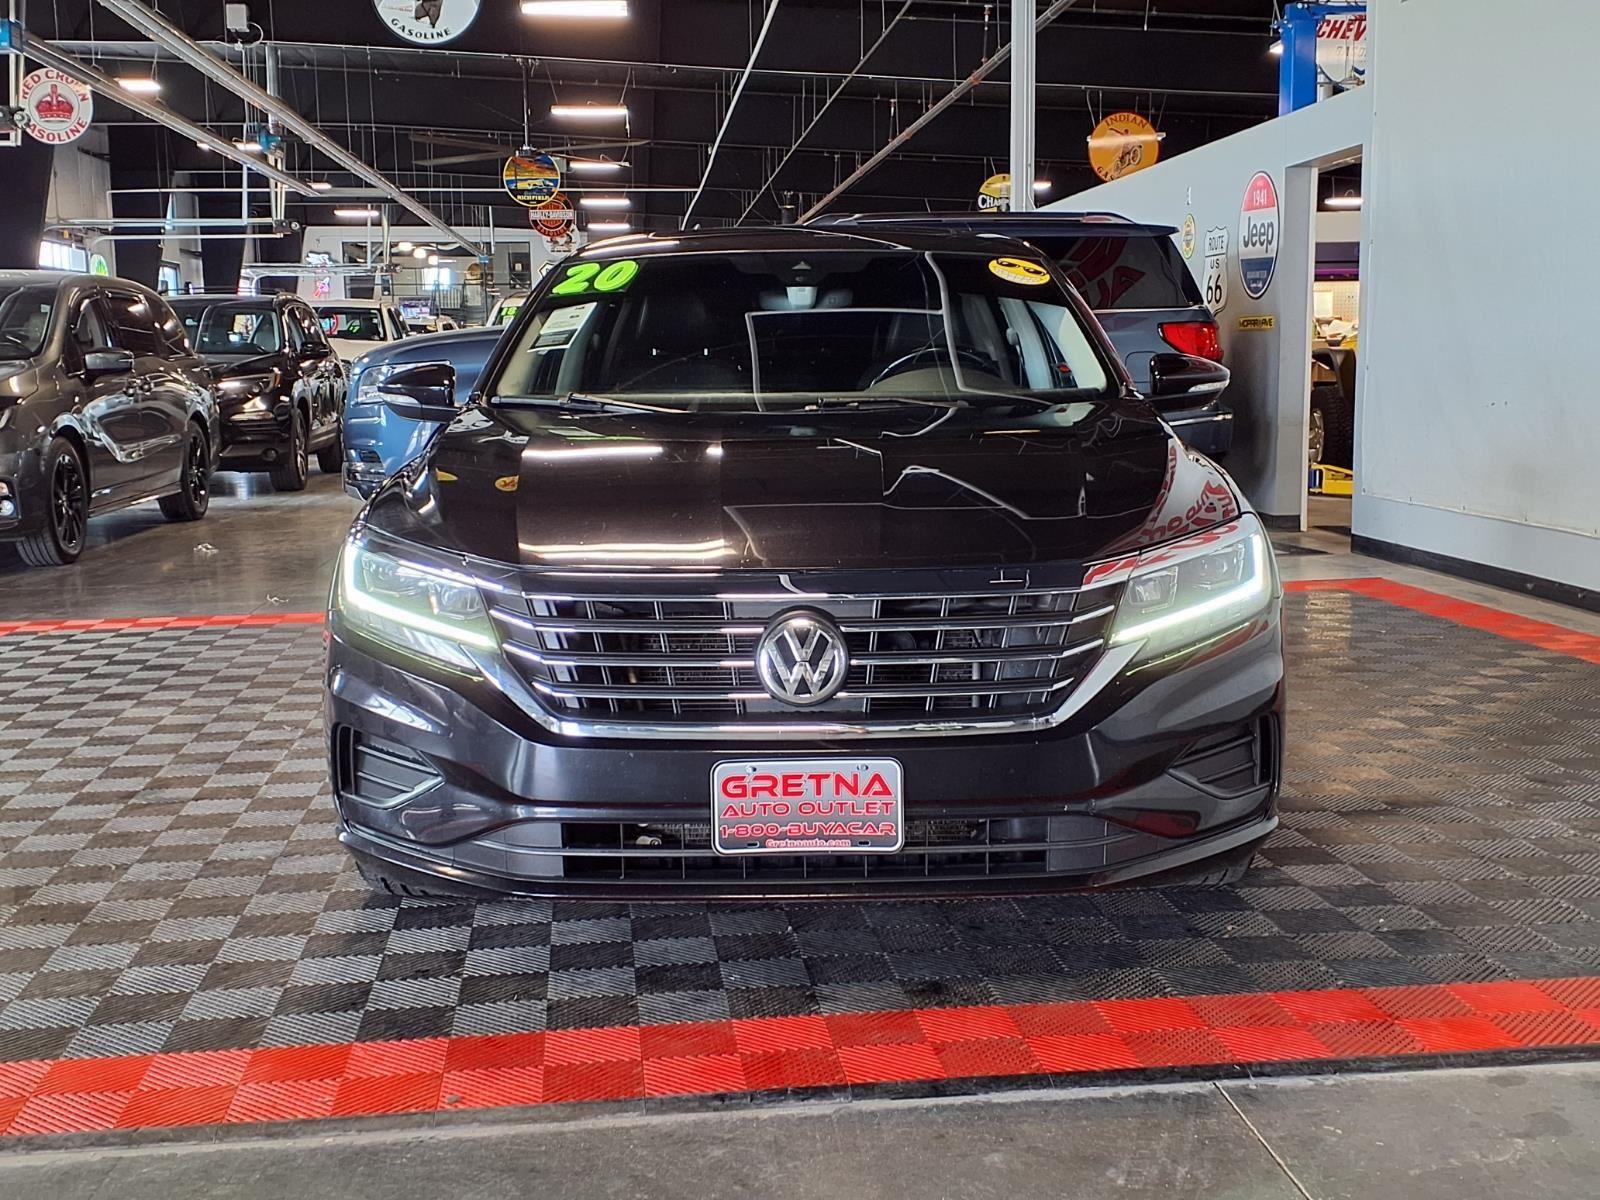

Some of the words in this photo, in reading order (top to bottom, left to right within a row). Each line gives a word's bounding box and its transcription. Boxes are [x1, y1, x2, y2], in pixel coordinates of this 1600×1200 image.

[391, 18, 452, 39] GASOLINE
[45, 69, 89, 102] CRON
[28, 117, 87, 142] ASOLINE
[1105, 113, 1149, 129] INDIAN
[1253, 188, 1268, 206] 1941
[1208, 235, 1225, 251] ROUTE
[1243, 216, 1274, 253] Jeep
[1209, 258, 1220, 270] US
[551, 260, 638, 295] 20
[1206, 273, 1222, 304] 66
[721, 772, 894, 799] GRETNA
[720, 801, 791, 818] AUTO
[798, 800, 895, 817] OUTLET
[720, 822, 896, 839] 1-800-BUYACAR
[766, 838, 851, 848] Gretnaauto.com
